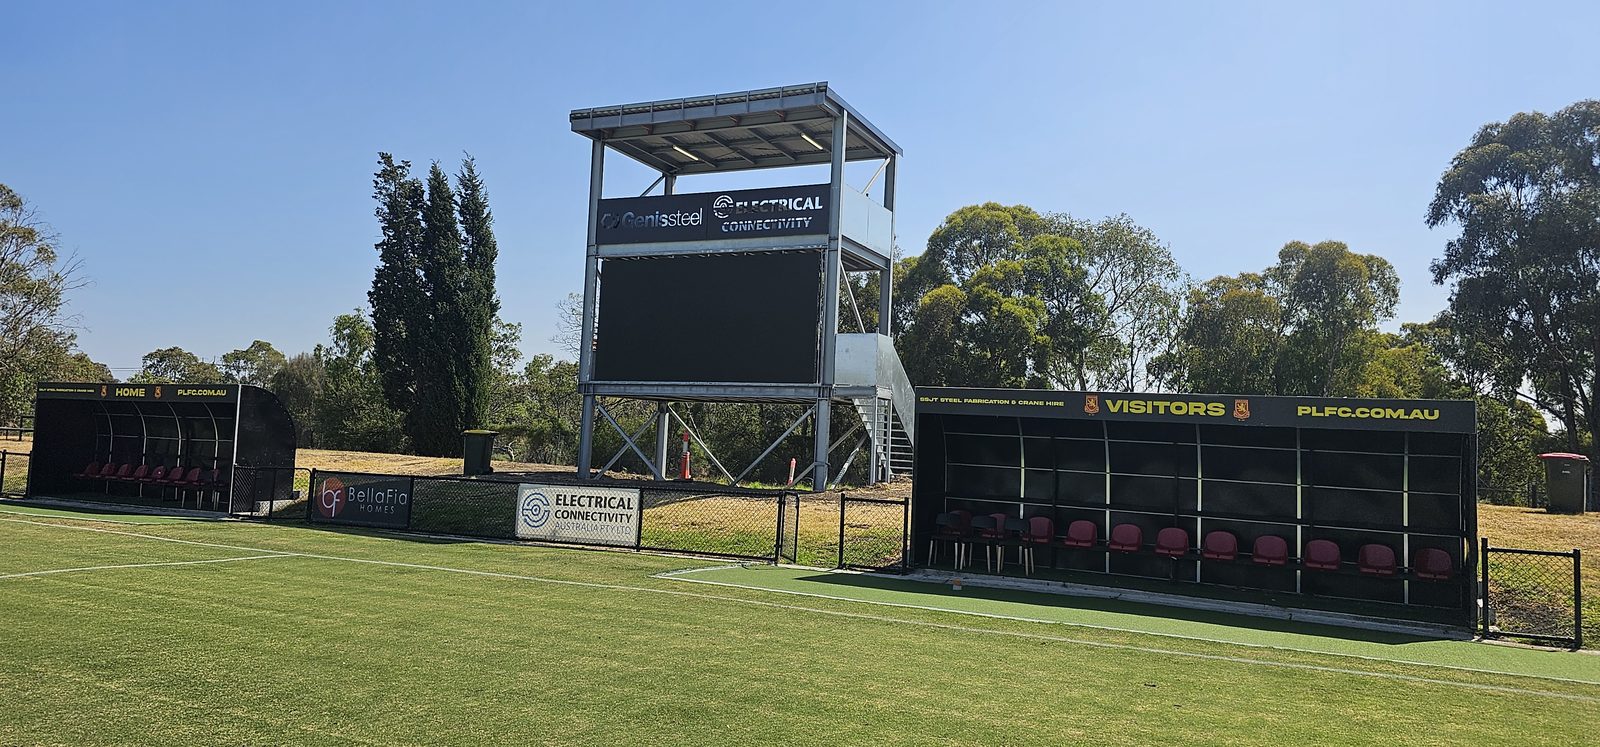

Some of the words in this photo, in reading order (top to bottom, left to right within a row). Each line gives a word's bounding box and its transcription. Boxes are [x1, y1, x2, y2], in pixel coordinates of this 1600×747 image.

[735, 196, 823, 214] ELECTRICAL
[721, 216, 813, 232] CONNECTIVITY
[115, 387, 146, 397] HOME
[177, 388, 227, 397] PLFC.COM.AU
[1105, 399, 1226, 417] VISITORS
[1296, 405, 1440, 420] PLFC.COM.AU
[348, 486, 408, 505] BellaFia
[556, 494, 633, 509] ELECTRICAL
[359, 504, 395, 514] HOMES
[555, 509, 632, 523] CONNECTIVITY
[555, 522, 598, 532] AUSTRALIA
